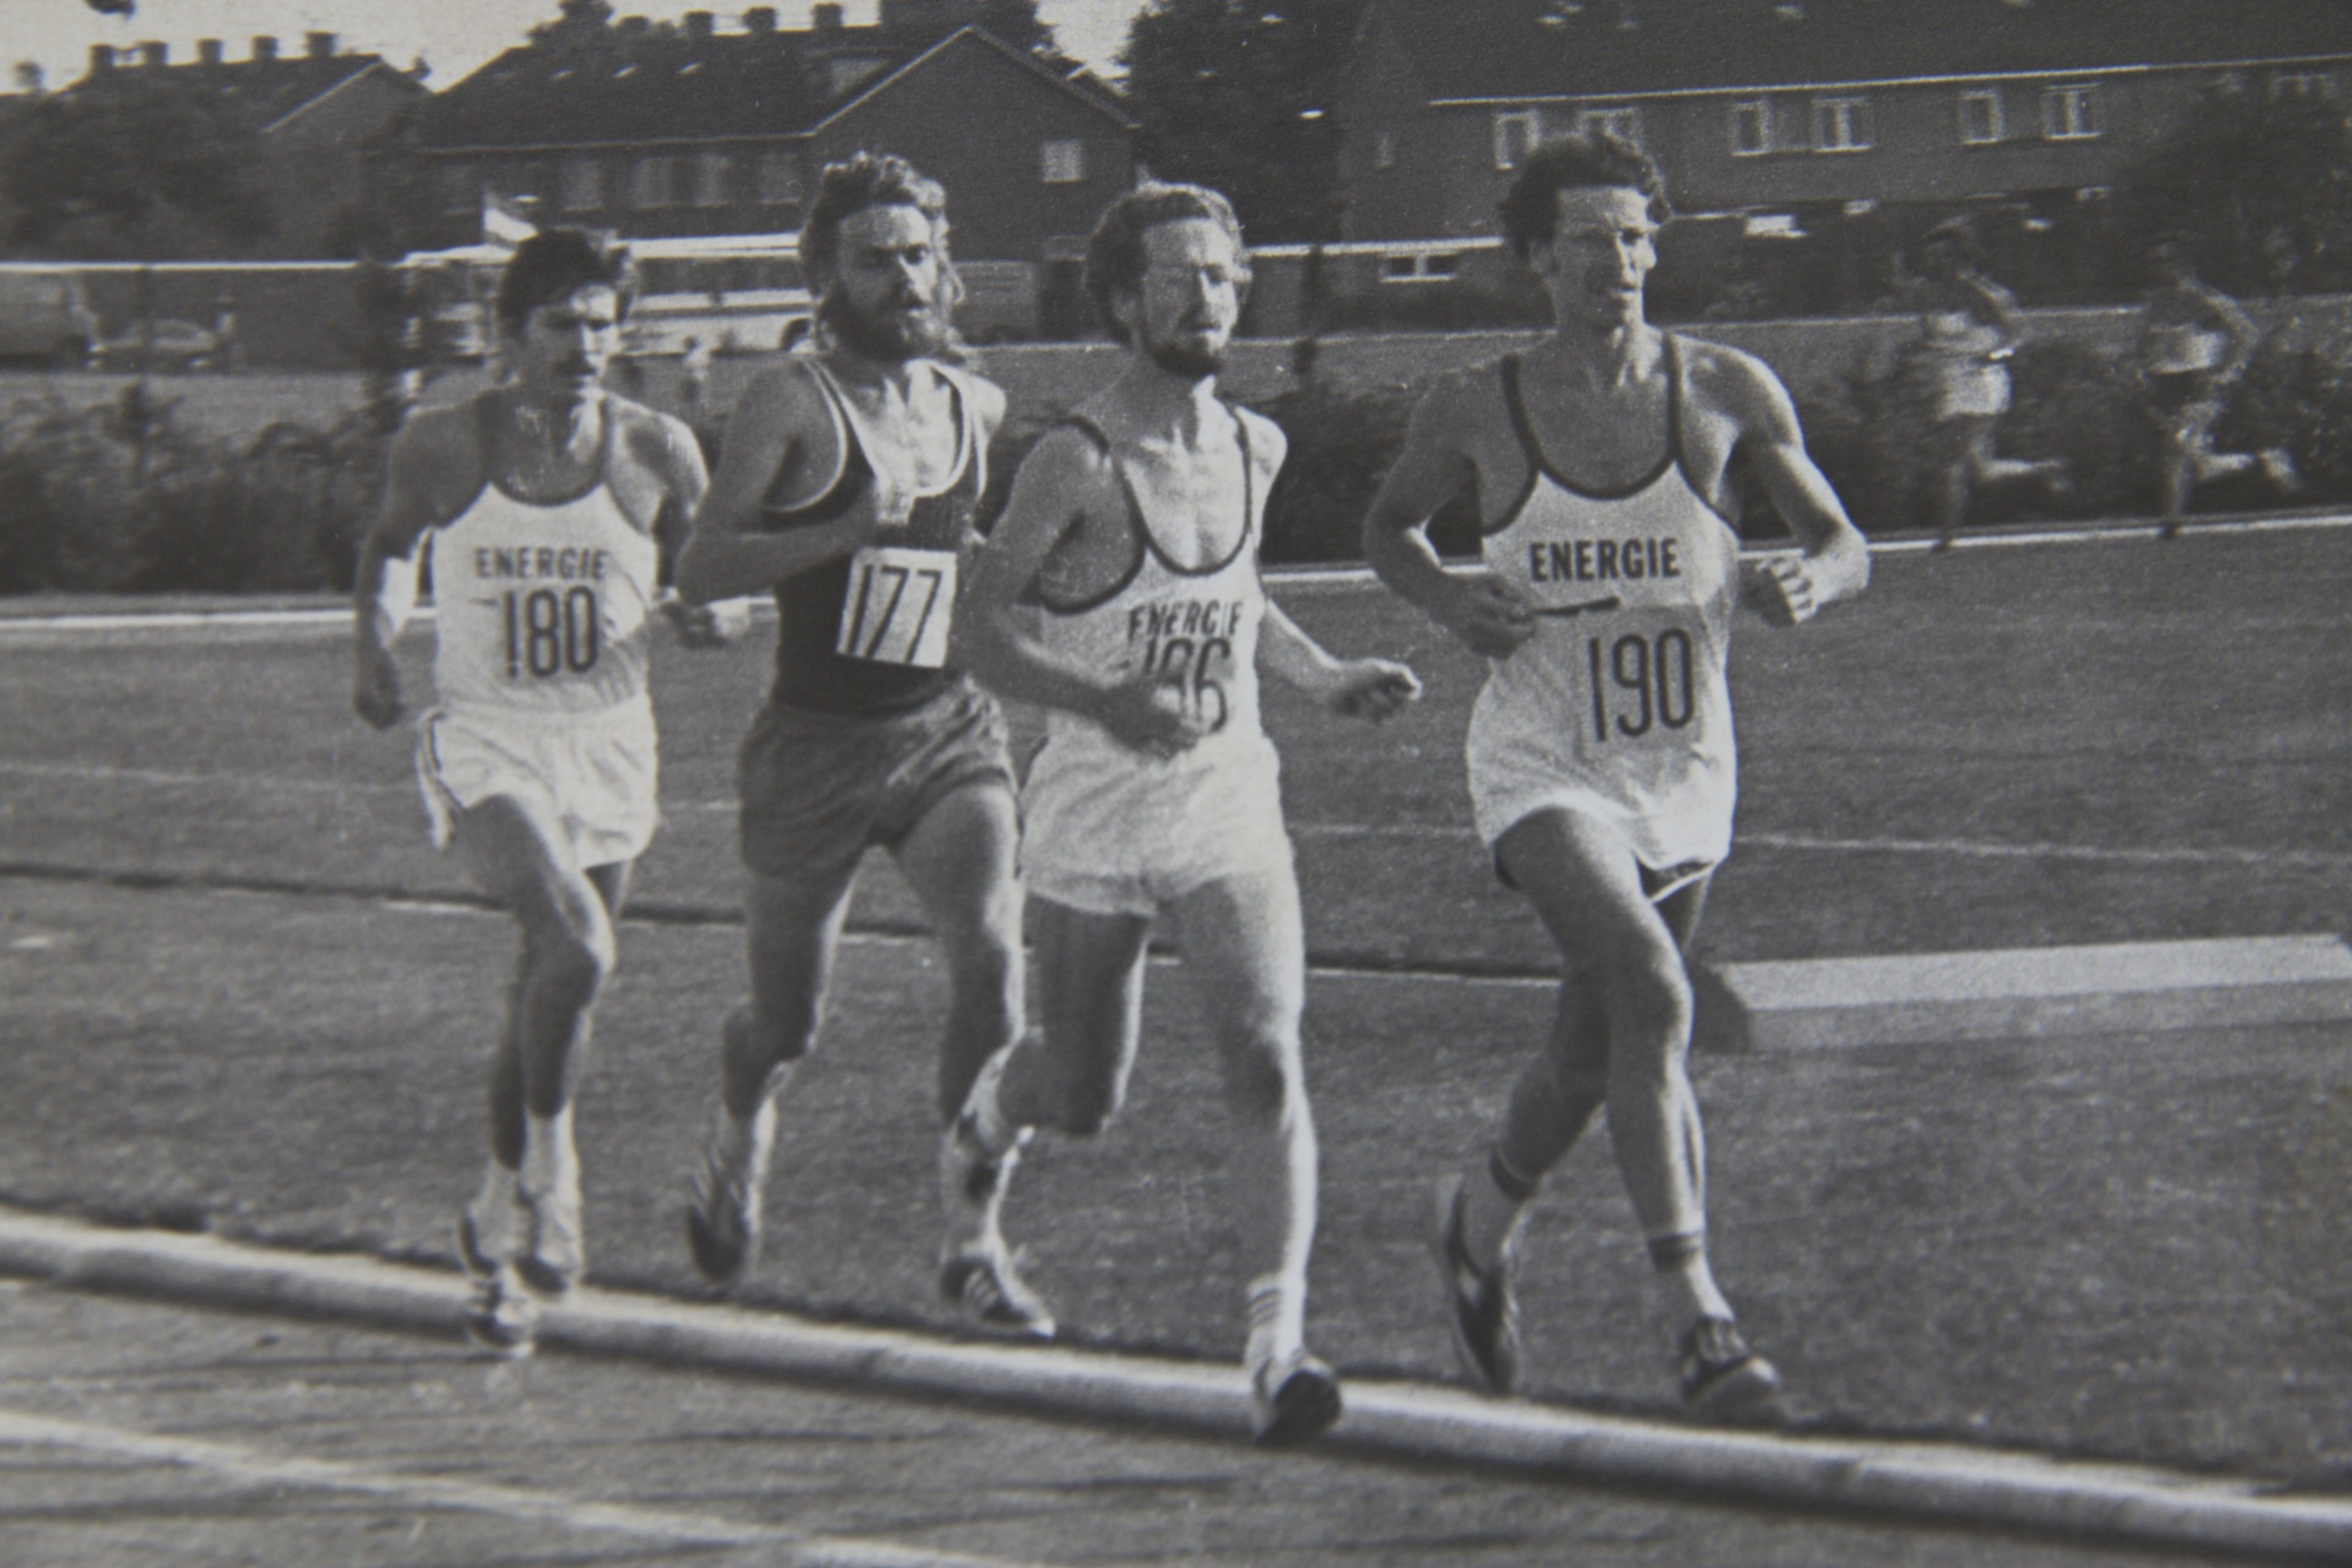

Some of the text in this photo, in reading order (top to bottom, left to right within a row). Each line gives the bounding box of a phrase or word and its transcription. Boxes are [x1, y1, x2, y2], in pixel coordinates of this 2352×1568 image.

[475, 546, 610, 580] ENERGIE
[1531, 537, 1681, 582] ENERGIE
[505, 586, 599, 678] 180
[846, 564, 942, 665] 177
[1591, 628, 1695, 742] 190
